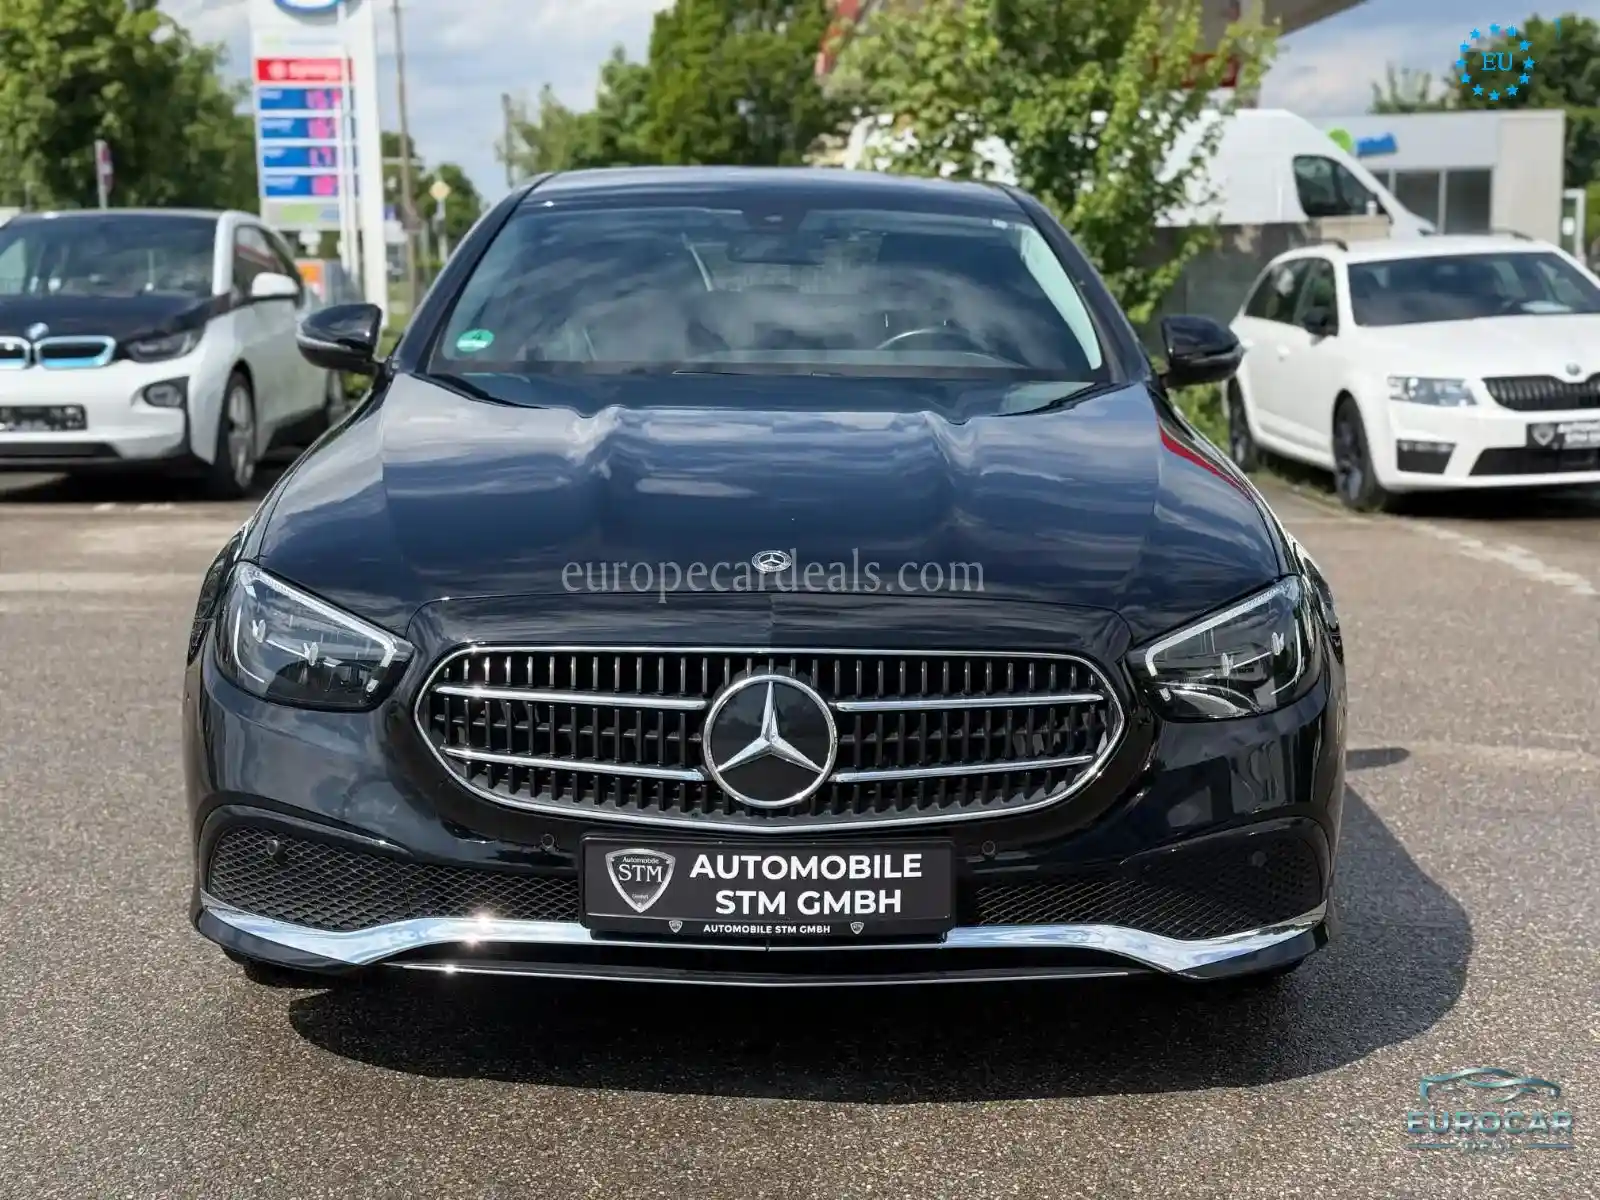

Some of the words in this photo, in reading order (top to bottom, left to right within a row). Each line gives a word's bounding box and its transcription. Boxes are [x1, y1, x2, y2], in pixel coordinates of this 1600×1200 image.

[618, 863, 664, 883] STM
[689, 852, 923, 880] AUTOMOBILE
[715, 889, 787, 916] STM
[796, 888, 902, 915] GMBH
[703, 923, 773, 935] AUTOMOBILE
[774, 924, 797, 935] STM
[799, 924, 831, 935] GMBH
